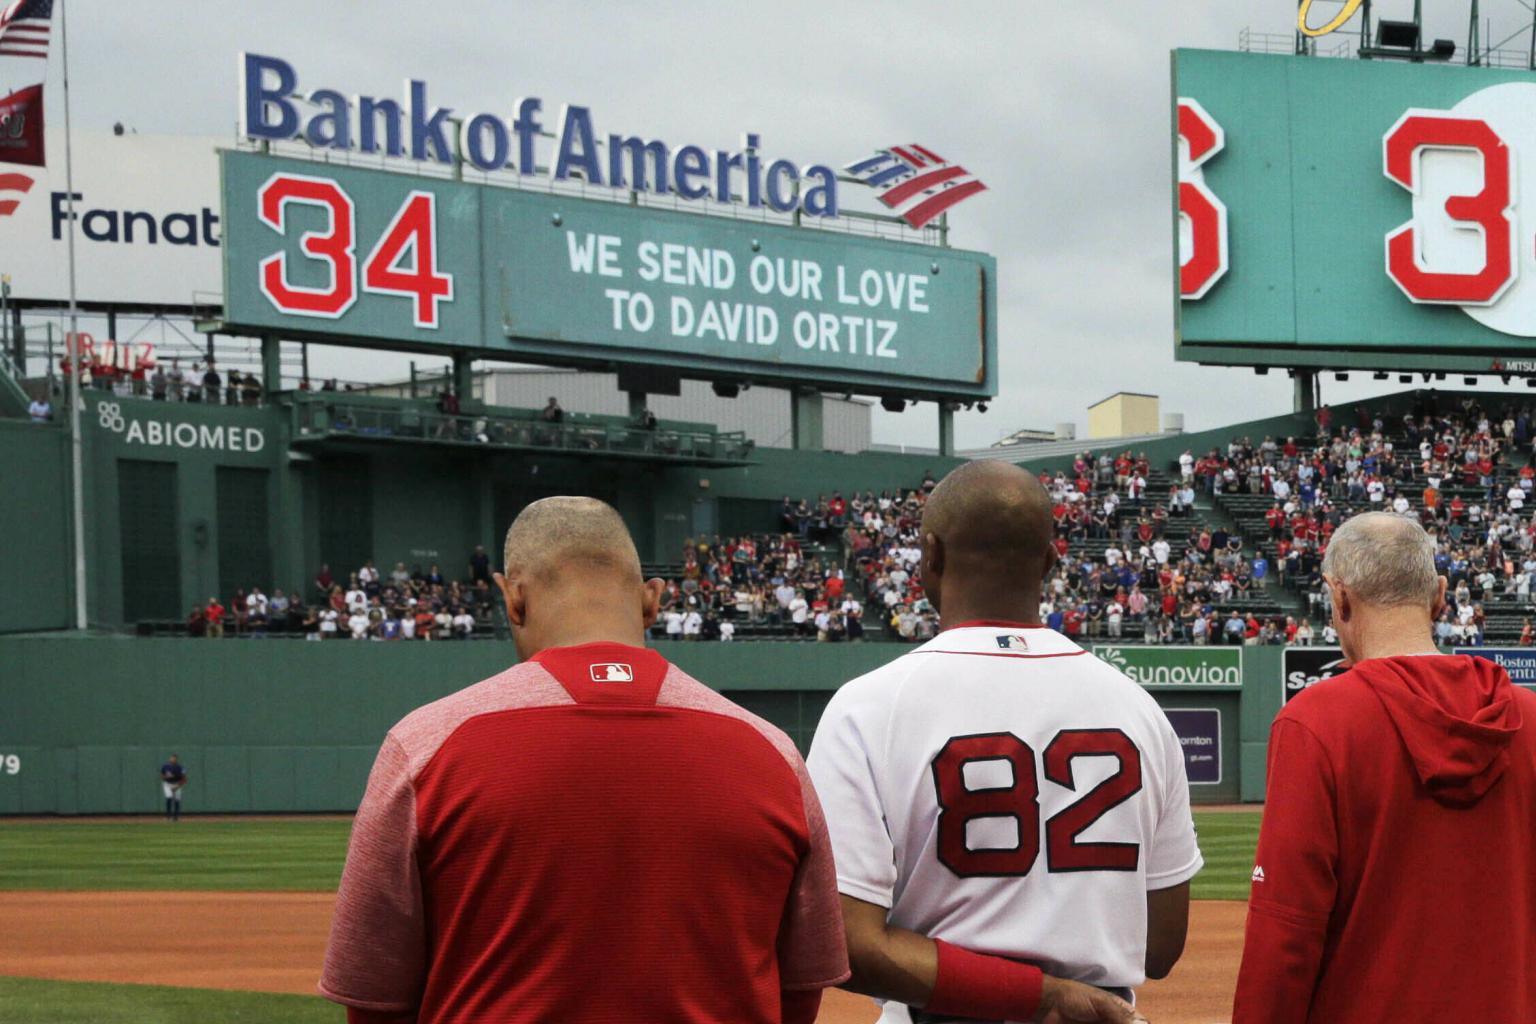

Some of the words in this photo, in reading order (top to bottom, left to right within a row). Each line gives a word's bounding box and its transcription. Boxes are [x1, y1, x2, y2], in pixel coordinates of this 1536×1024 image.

[239, 51, 457, 164] Bank
[461, 97, 545, 177] of
[549, 103, 839, 218] America
[257, 171, 454, 329] 34
[567, 231, 622, 278] WE
[637, 242, 735, 290] SEND
[749, 255, 822, 300] OUR
[837, 265, 929, 313] LOVE
[605, 290, 654, 332] TO
[671, 297, 779, 345] DAVID
[793, 311, 898, 358] ORTIZ
[126, 419, 264, 452] ABIOMED
[1125, 661, 1239, 683] sunovion
[1495, 654, 1536, 668] Boston
[931, 728, 1143, 879] 82
